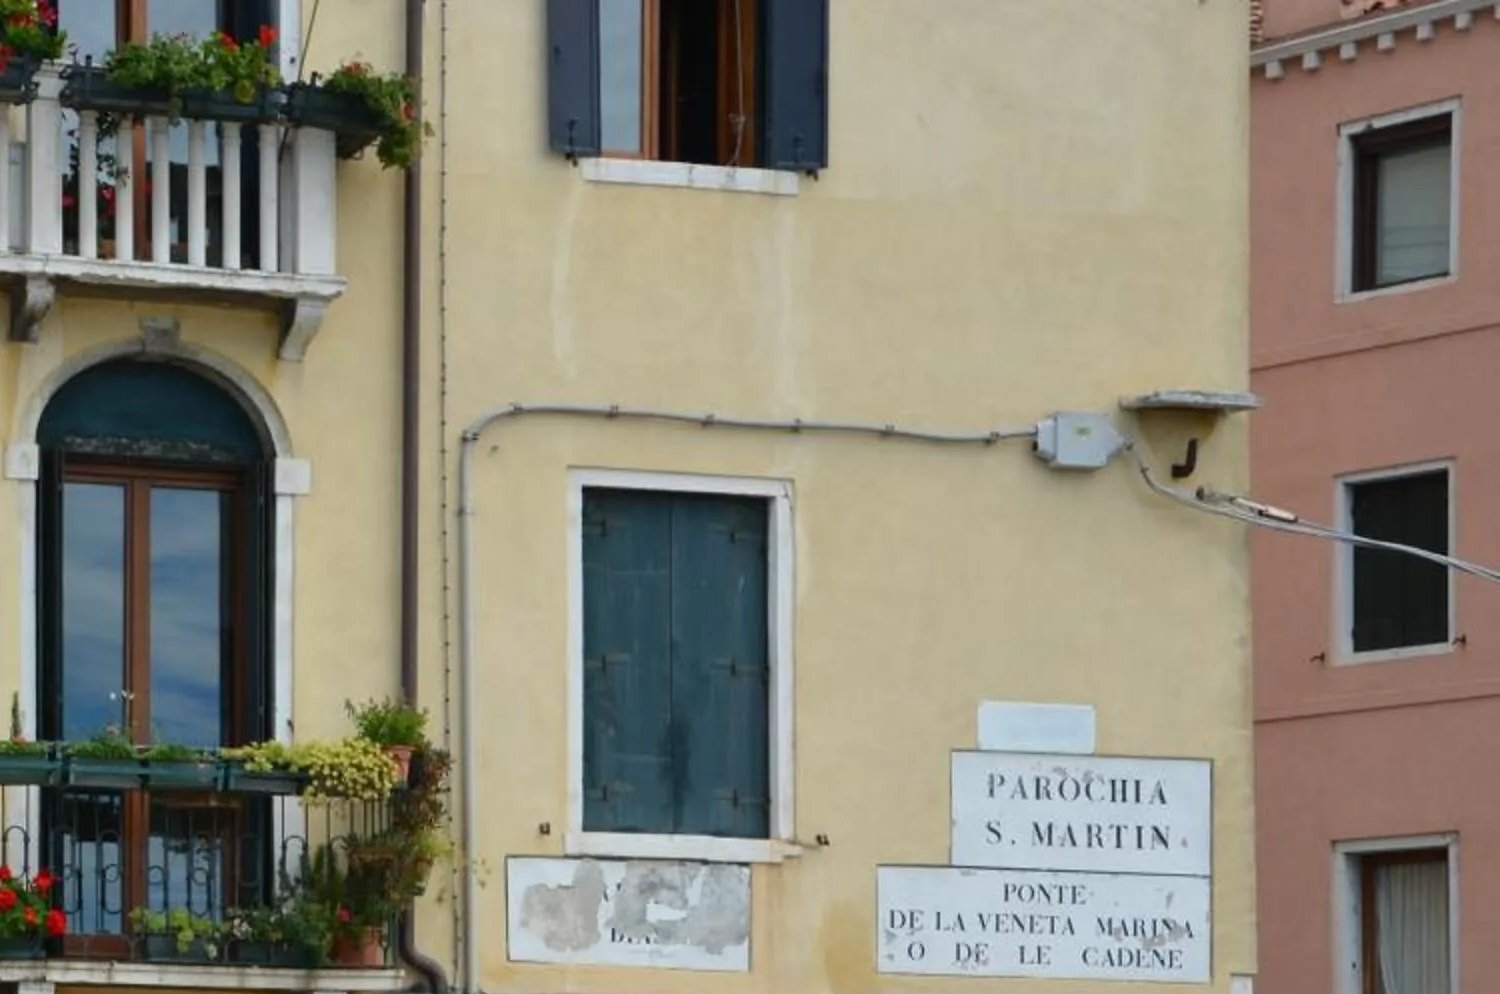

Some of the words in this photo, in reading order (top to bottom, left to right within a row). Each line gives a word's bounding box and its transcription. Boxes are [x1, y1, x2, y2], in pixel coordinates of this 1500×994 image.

[986, 773, 1168, 805] PAROCHIA
[985, 820, 1016, 847] S.
[1031, 822, 1171, 850] MARTIN
[1003, 883, 1087, 905] PONTE
[889, 909, 924, 931] DE
[935, 911, 965, 932] LA
[977, 913, 1076, 935] VENETA
[1096, 916, 1195, 939] MARINA
[907, 942, 925, 961] O
[955, 943, 989, 964] DE
[1019, 945, 1052, 966] LE
[1081, 946, 1183, 970] CADENE
